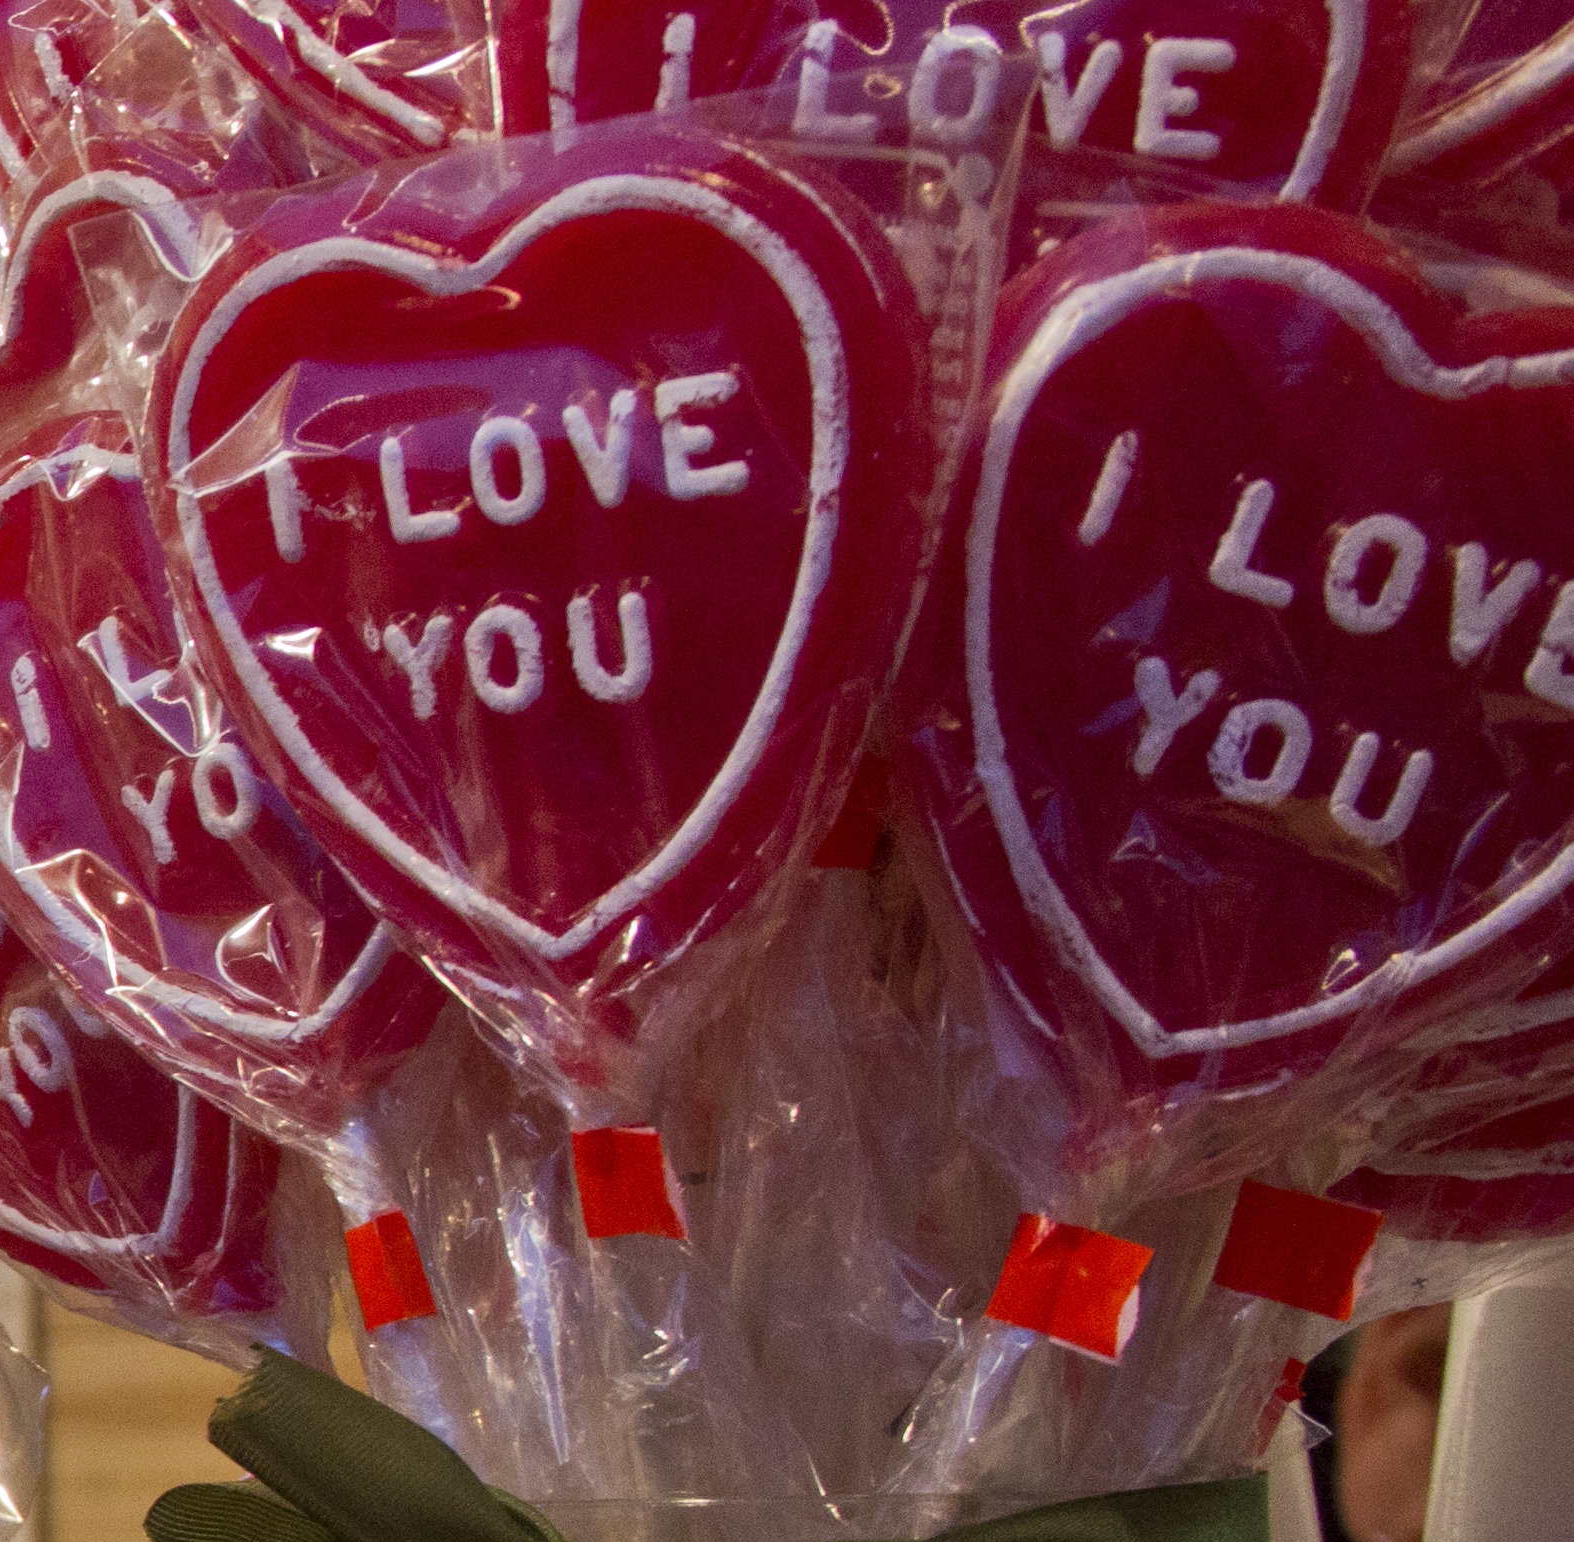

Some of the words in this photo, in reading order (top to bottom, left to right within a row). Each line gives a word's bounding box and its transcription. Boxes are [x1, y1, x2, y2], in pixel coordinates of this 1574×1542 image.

[653, 13, 695, 113] I
[793, 18, 1237, 160] LOVE
[264, 455, 307, 563] I
[379, 371, 750, 544] LOVE
[1077, 430, 1138, 547] I
[10, 654, 51, 750] I
[383, 592, 653, 720] YOU
[121, 741, 264, 866] YO
[1132, 655, 1434, 848] YOU
